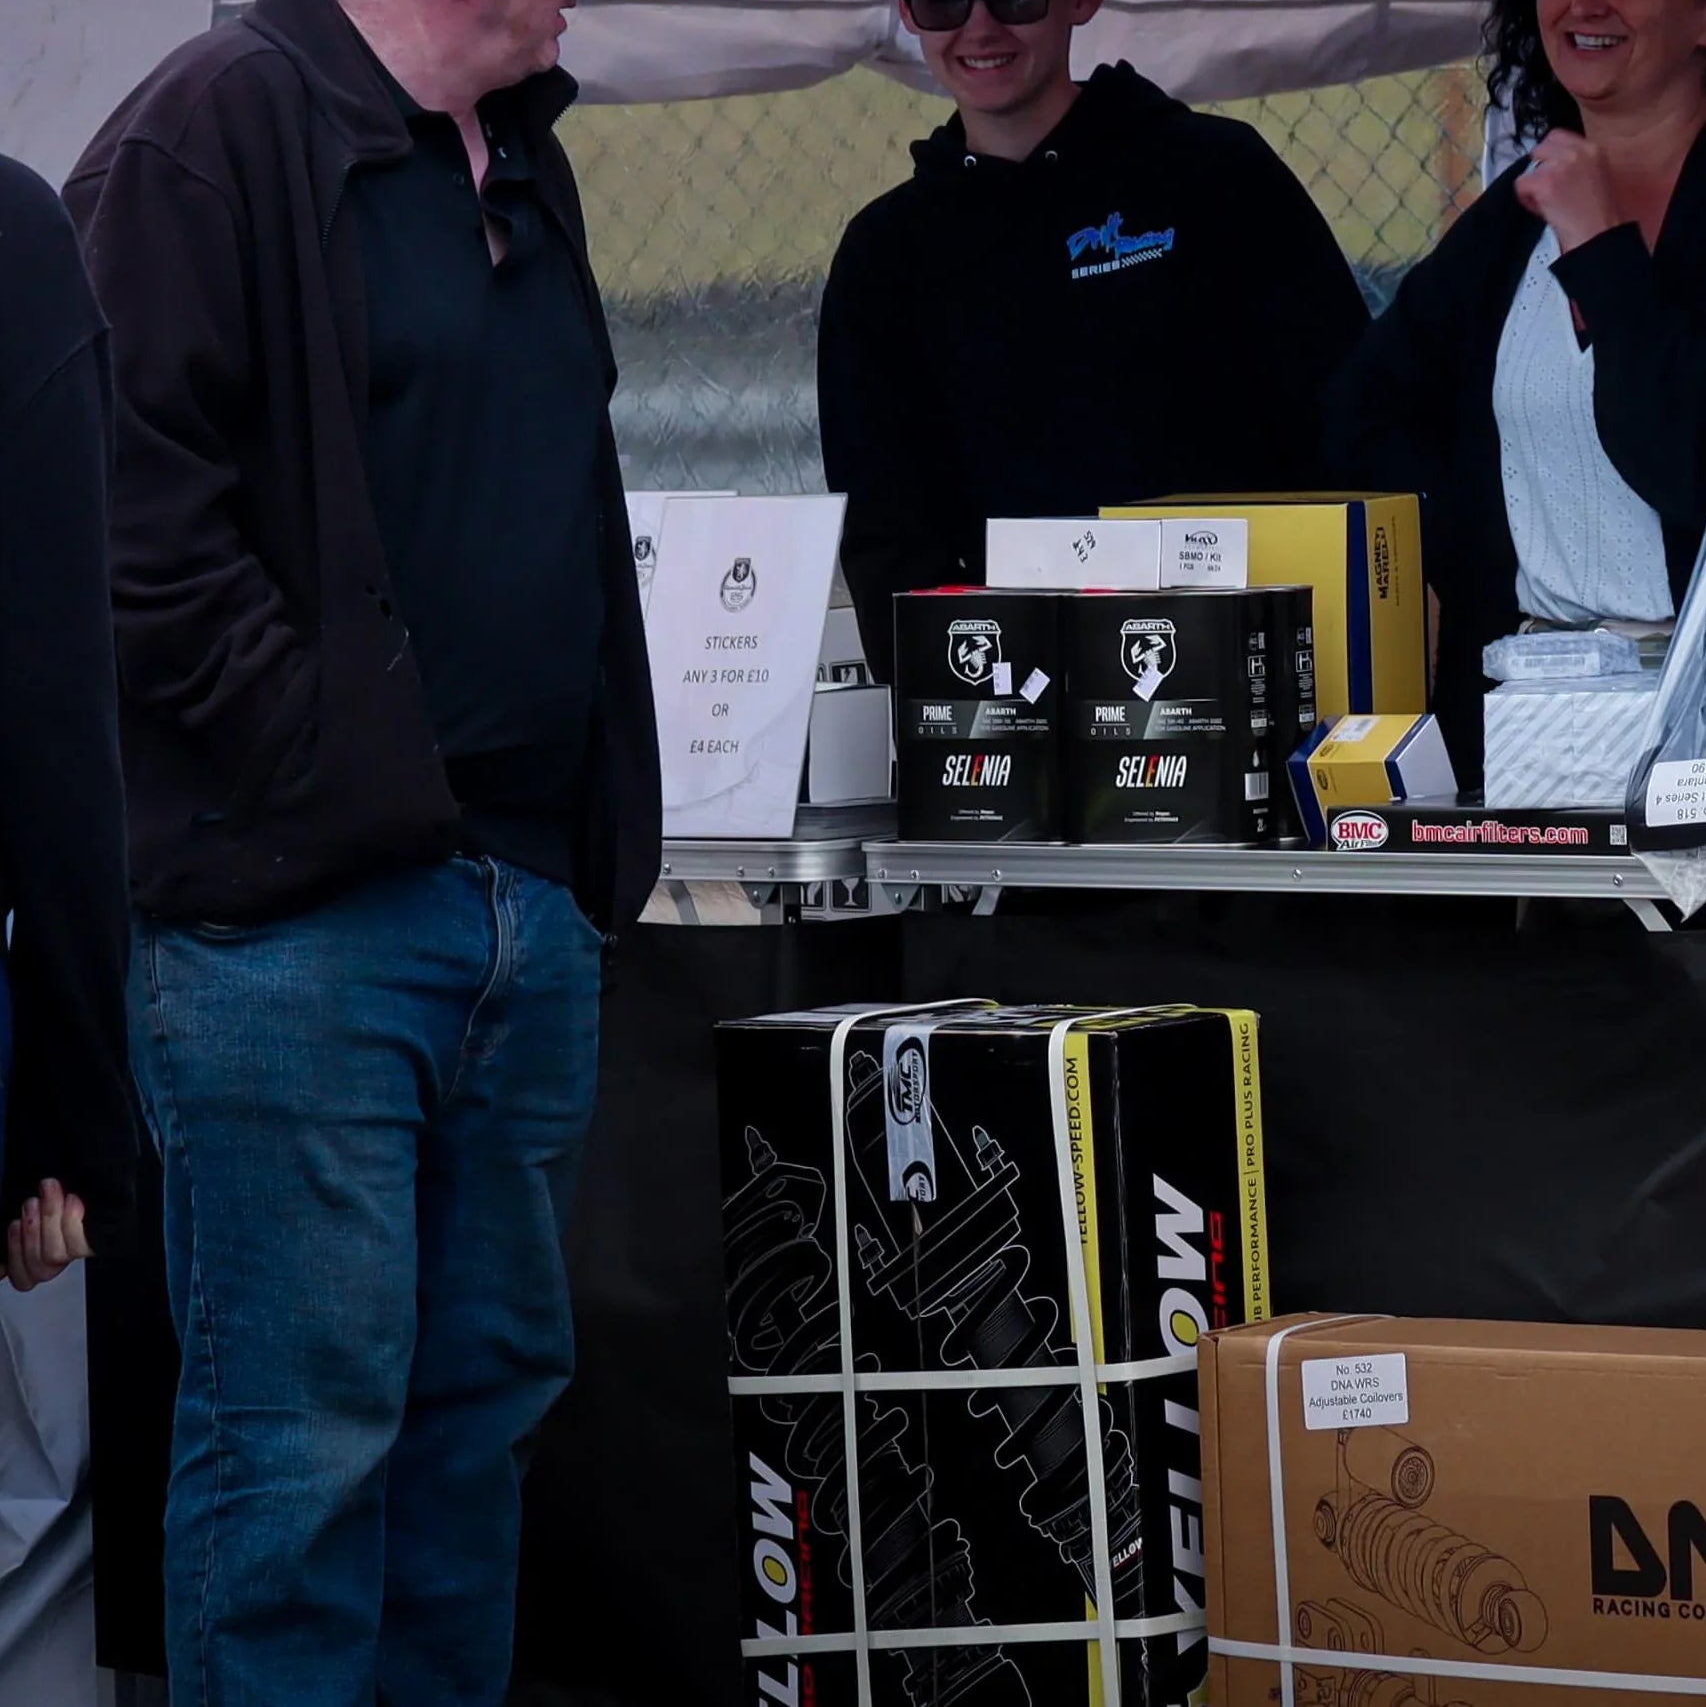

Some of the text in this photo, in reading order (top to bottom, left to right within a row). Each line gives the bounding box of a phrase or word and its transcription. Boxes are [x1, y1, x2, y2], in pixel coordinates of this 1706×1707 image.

[952, 623, 998, 632] ABARTH
[1125, 622, 1171, 631] ABARTH
[704, 635, 758, 651] STICKERS
[683, 669, 769, 684] ANY 3 FOR £10
[711, 703, 729, 718] OR
[922, 705, 952, 722] PRIME
[985, 707, 1017, 716] ABARTH
[1095, 705, 1126, 722] PRIME
[1160, 707, 1193, 716] ABARTH
[689, 739, 739, 755] £4 EACH
[942, 754, 1012, 787] SELENIA
[1115, 754, 1188, 788] SELENIA
[1655, 795, 1663, 806] 4
[1665, 792, 1699, 804] Series
[1677, 808, 1697, 820] 518
[1338, 822, 1382, 839] BMC
[1411, 820, 1589, 845] bmcairfilters.com
[1239, 1022, 1253, 1087] RACING
[900, 1062, 912, 1113] TMC
[1242, 1090, 1254, 1129] PLUS
[1244, 1134, 1256, 1167] PRO
[1247, 1178, 1263, 1301] PERFORMANCE
[1336, 1362, 1373, 1376] No. 532
[1331, 1377, 1380, 1391] DNA WRS
[1308, 1391, 1404, 1409] Adjustable Coilovers
[1342, 1408, 1373, 1421] £1740
[749, 1452, 799, 1707] LLOW
[1593, 1598, 1671, 1619] RACING
